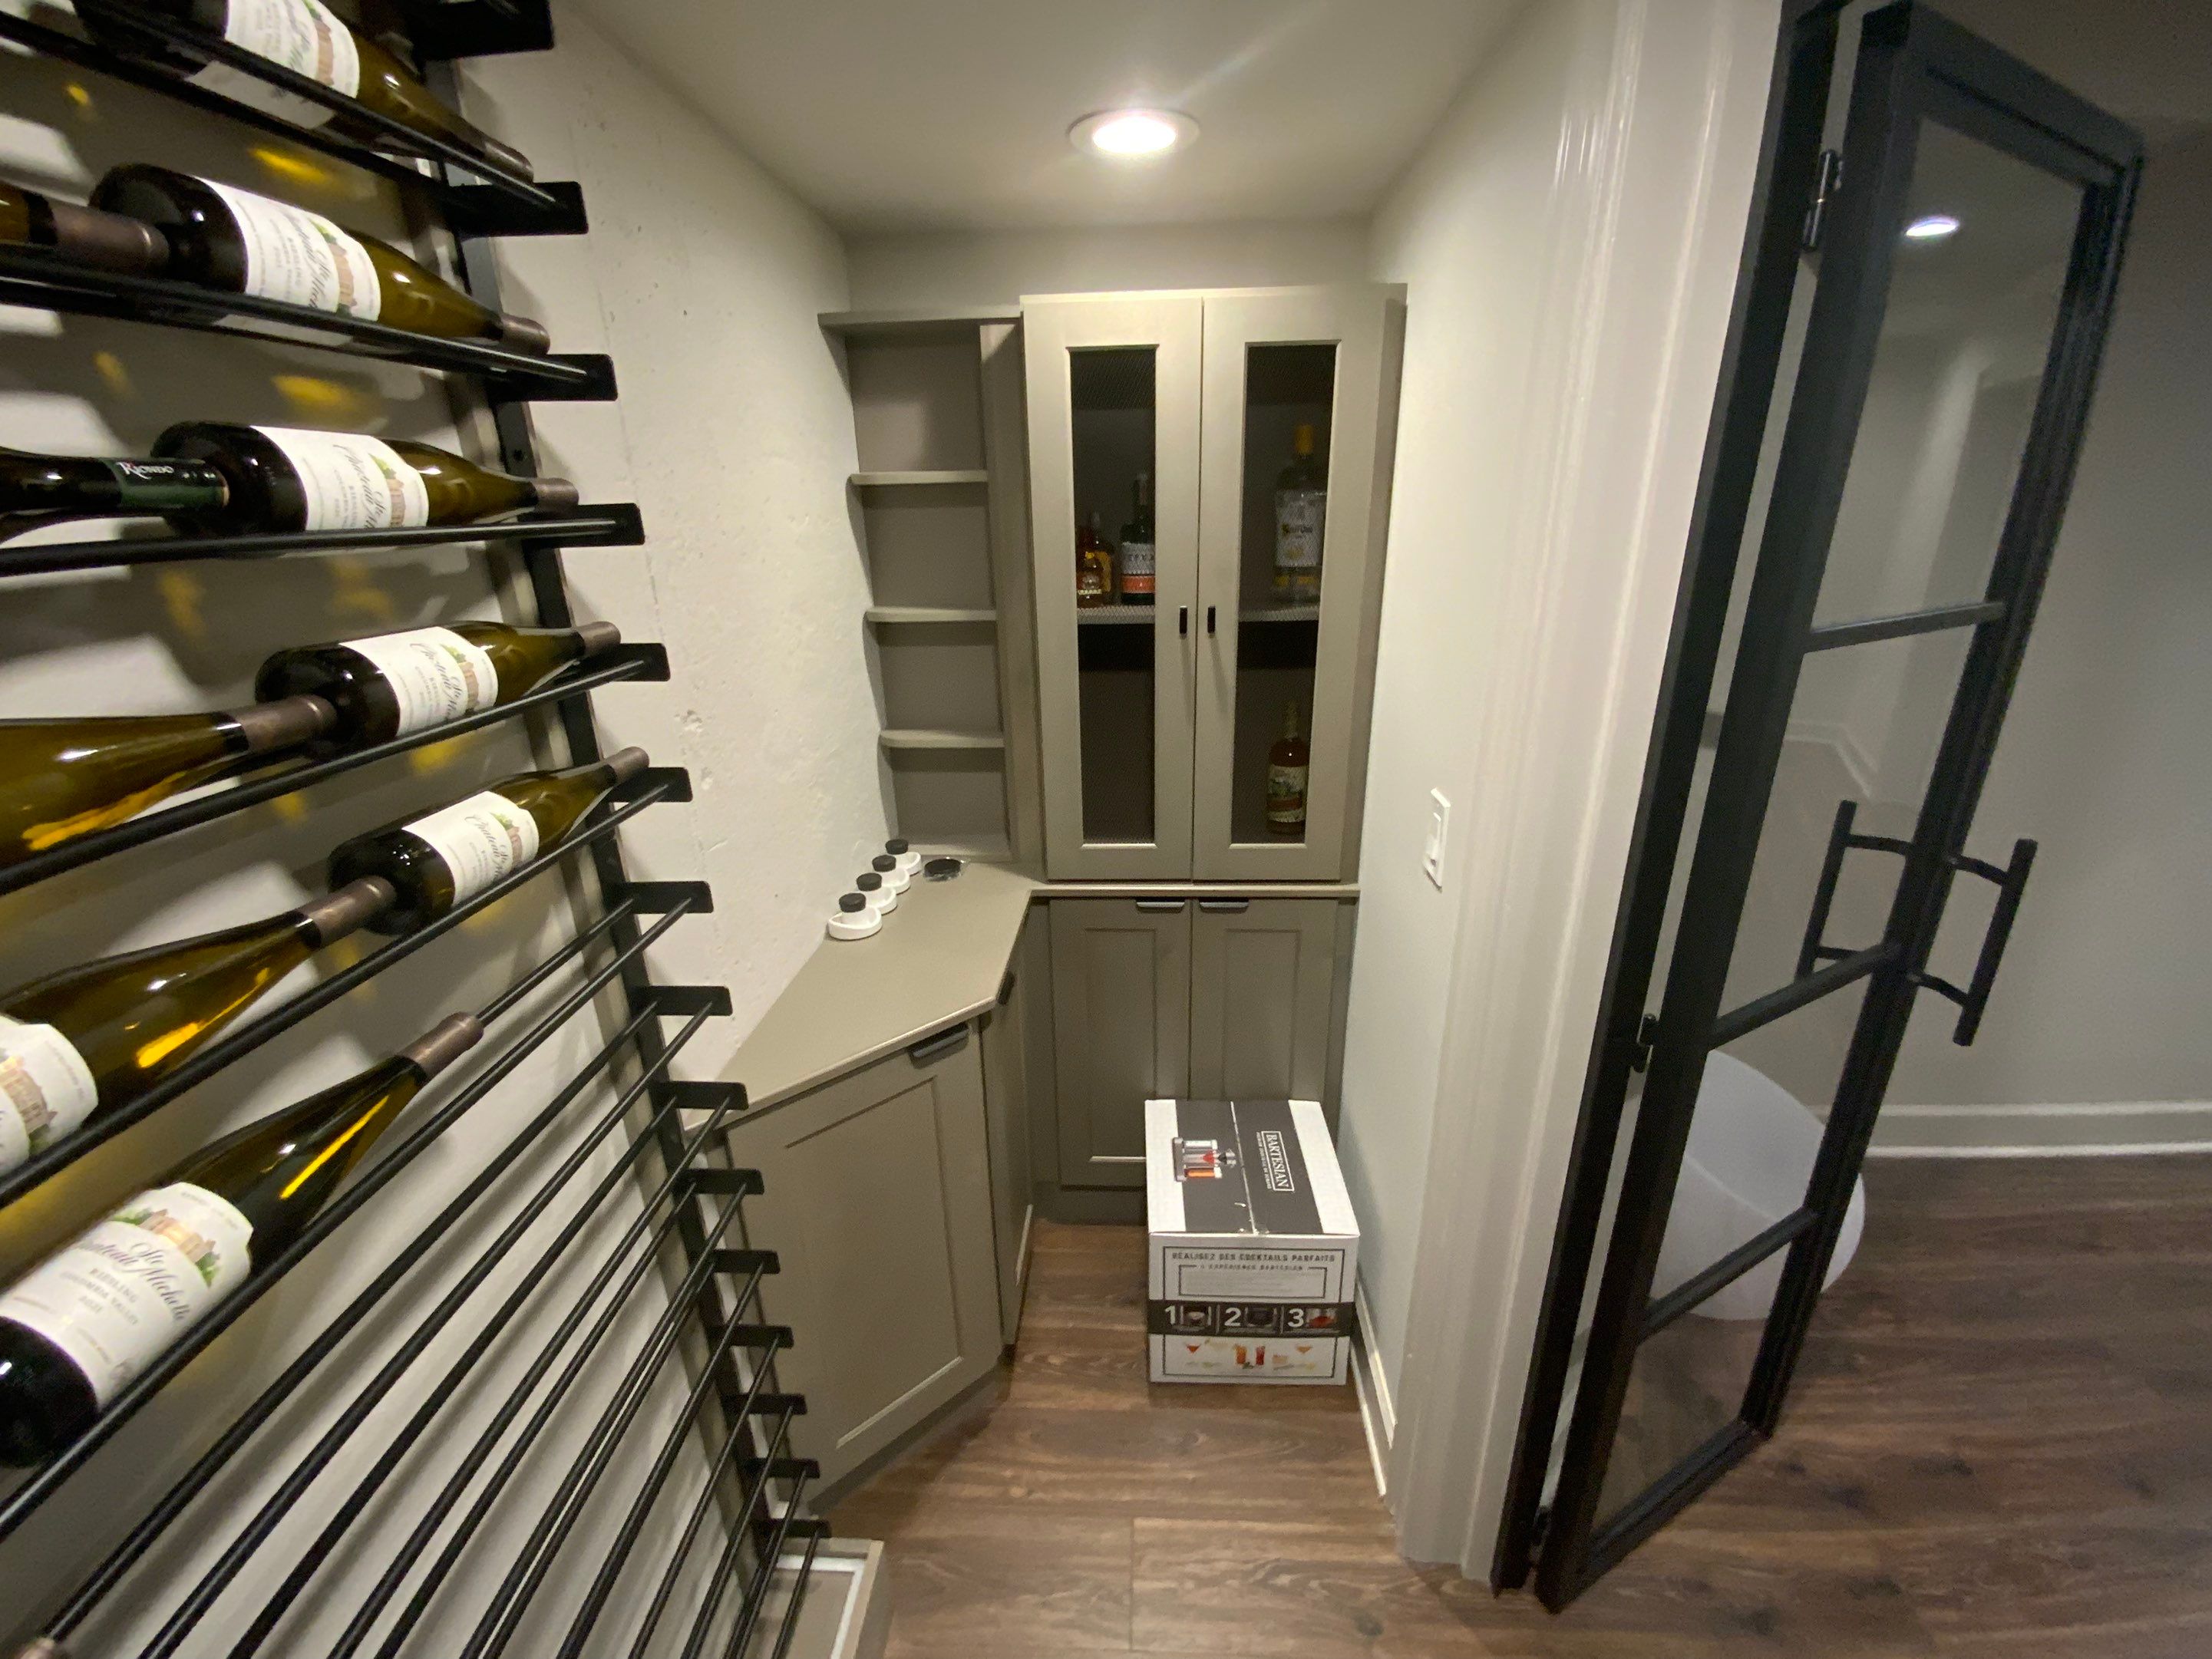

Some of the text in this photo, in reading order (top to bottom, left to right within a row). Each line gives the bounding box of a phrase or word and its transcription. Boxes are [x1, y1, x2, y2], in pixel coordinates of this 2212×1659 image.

[464, 814, 501, 862] Chateau
[1266, 1134, 1289, 1188] BARTESIAN
[130, 1242, 165, 1265] Ste
[1240, 1253, 1288, 1262] COCKTAILS
[89, 1268, 140, 1304] RIESLING
[1164, 1305, 1304, 1328] 1 2 3
